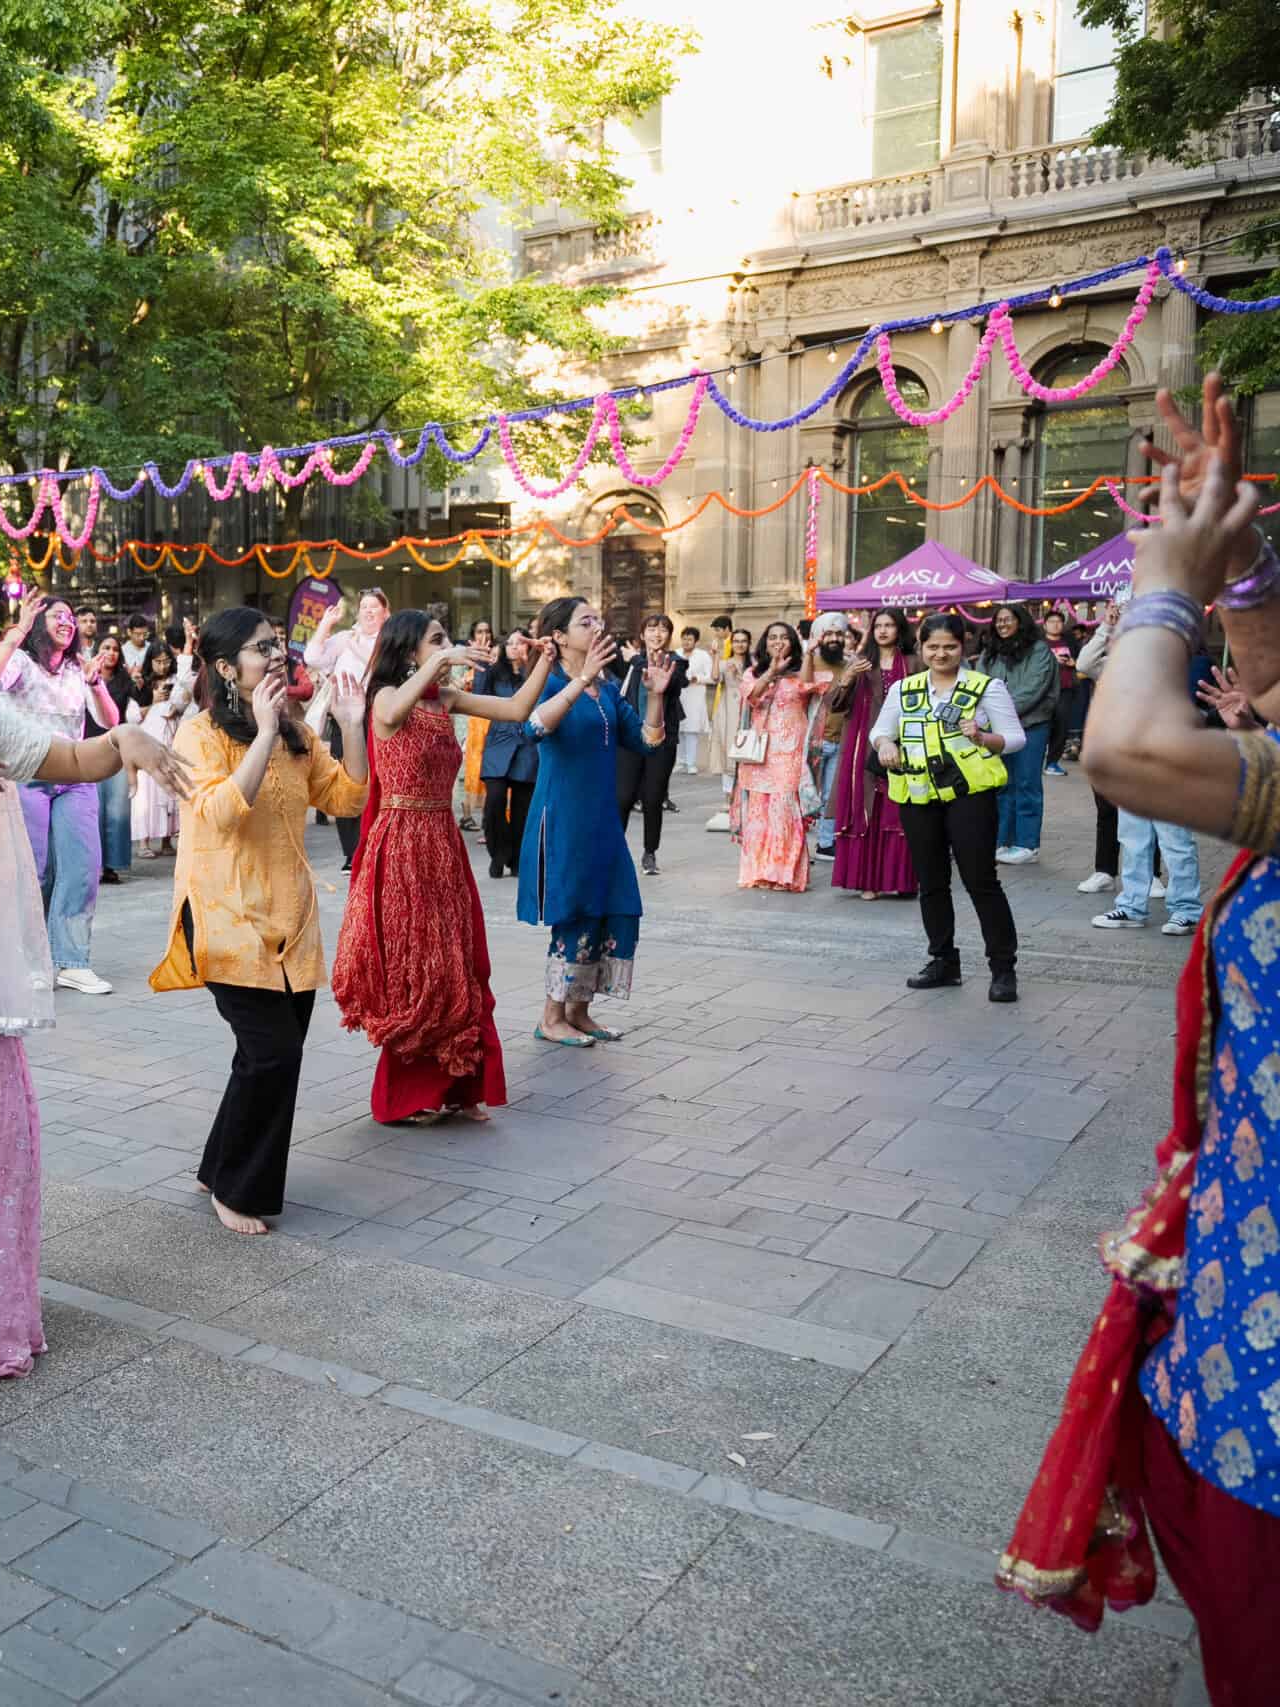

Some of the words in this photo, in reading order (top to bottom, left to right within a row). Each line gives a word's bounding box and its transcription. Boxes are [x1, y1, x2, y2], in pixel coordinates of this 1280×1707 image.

[872, 569, 955, 589] UMSU
[1080, 558, 1136, 580] UM
[881, 592, 927, 606] UMSU
